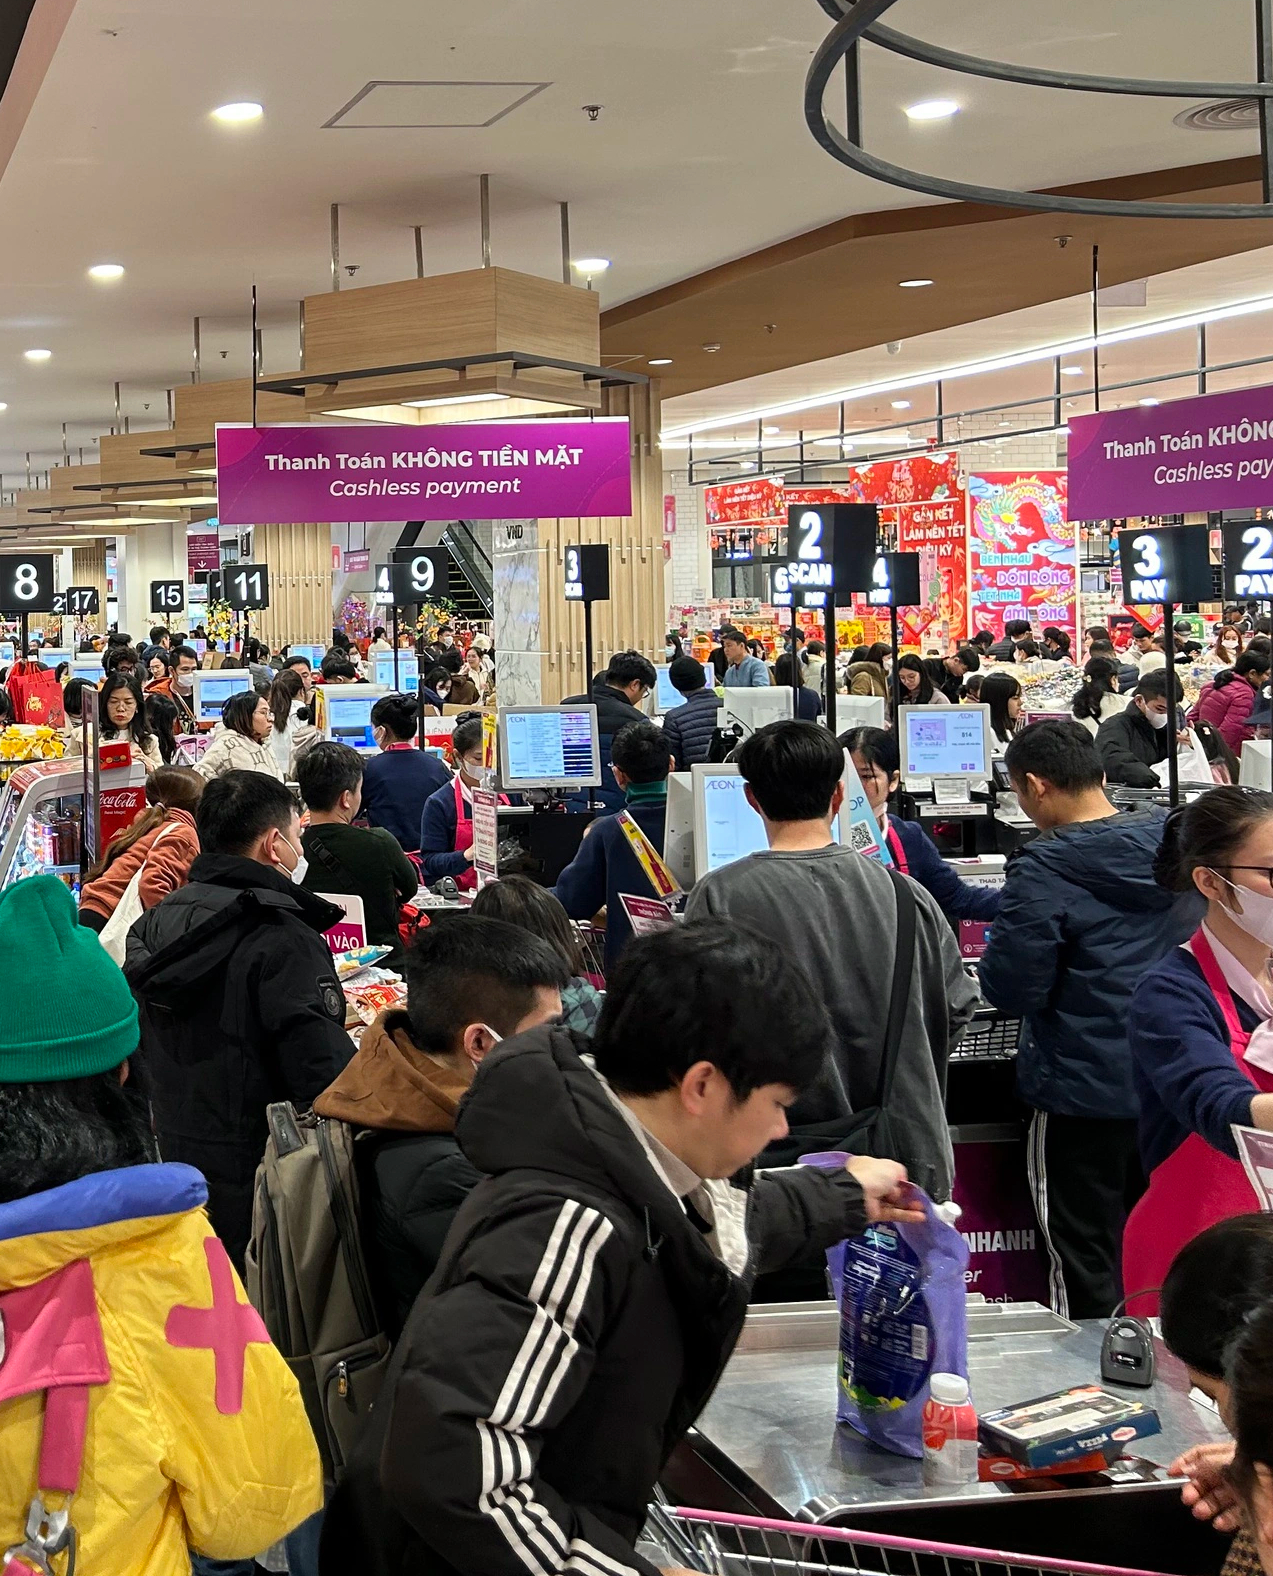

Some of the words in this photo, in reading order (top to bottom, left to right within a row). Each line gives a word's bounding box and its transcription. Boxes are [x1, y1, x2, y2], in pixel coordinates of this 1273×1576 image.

[265, 453, 330, 471] Thanh
[336, 451, 386, 469] Toán
[392, 447, 473, 469] KHÔNG
[479, 443, 528, 467] TIỀN
[536, 445, 583, 469] MẶT
[1103, 437, 1156, 460] Thanh
[1160, 431, 1202, 453] Toán
[1154, 460, 1233, 484] Cashless
[329, 478, 421, 497] Cashless
[426, 477, 521, 498] payment
[935, 504, 954, 520] KẾT
[799, 511, 823, 560] 2
[947, 521, 965, 538] TẾT
[1003, 553, 1033, 565] NHAU
[1132, 535, 1162, 577] 3
[1241, 526, 1273, 571] 2
[411, 556, 435, 591] 9
[567, 550, 578, 581] 3
[788, 562, 834, 587] SCAN
[872, 557, 889, 587] 4
[14, 563, 39, 600] 8
[234, 571, 262, 601] 11
[378, 567, 389, 591] 4
[775, 567, 790, 592] 6
[1130, 579, 1167, 601] PAY
[53, 596, 66, 611] 2
[156, 585, 181, 606] 15
[331, 931, 360, 950] VÀO
